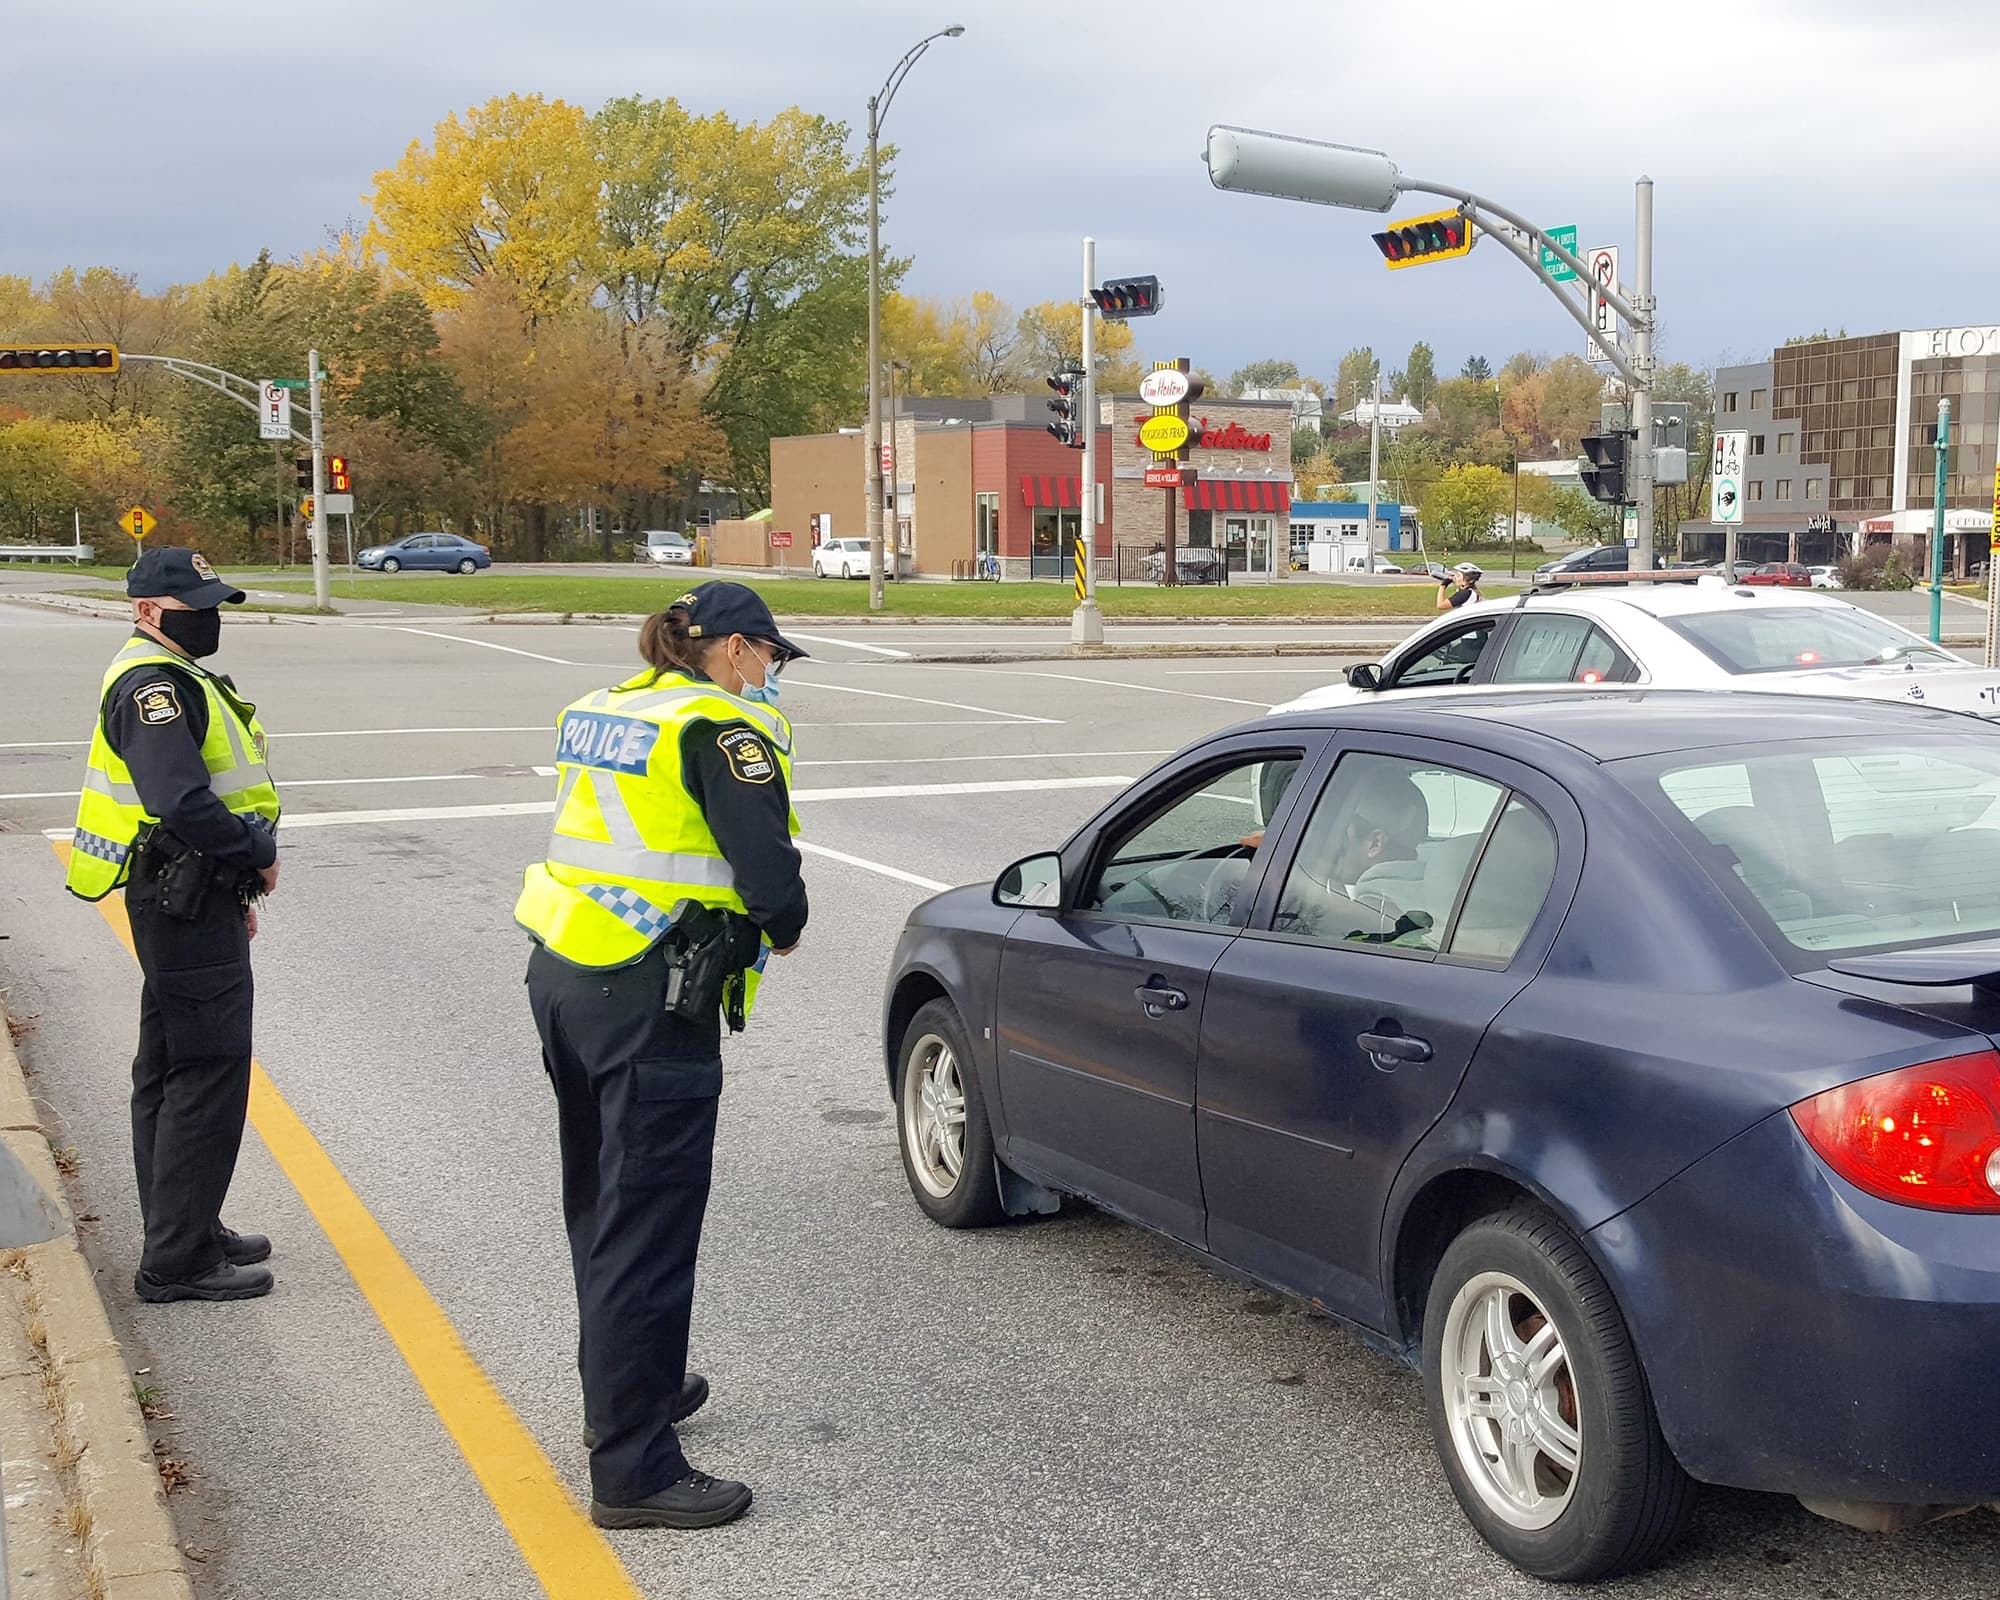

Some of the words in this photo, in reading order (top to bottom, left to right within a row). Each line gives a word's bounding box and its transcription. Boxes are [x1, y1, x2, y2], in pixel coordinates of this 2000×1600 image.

[1545, 264, 1569, 274] SEULEMEN
[1144, 379, 1156, 398] Tim
[1157, 376, 1185, 397] Hortons
[1169, 426, 1185, 439] FRAIS
[1200, 415, 1271, 451] ortons
[1946, 517, 1991, 528] CEPTIO
[562, 718, 647, 765] POLICE
